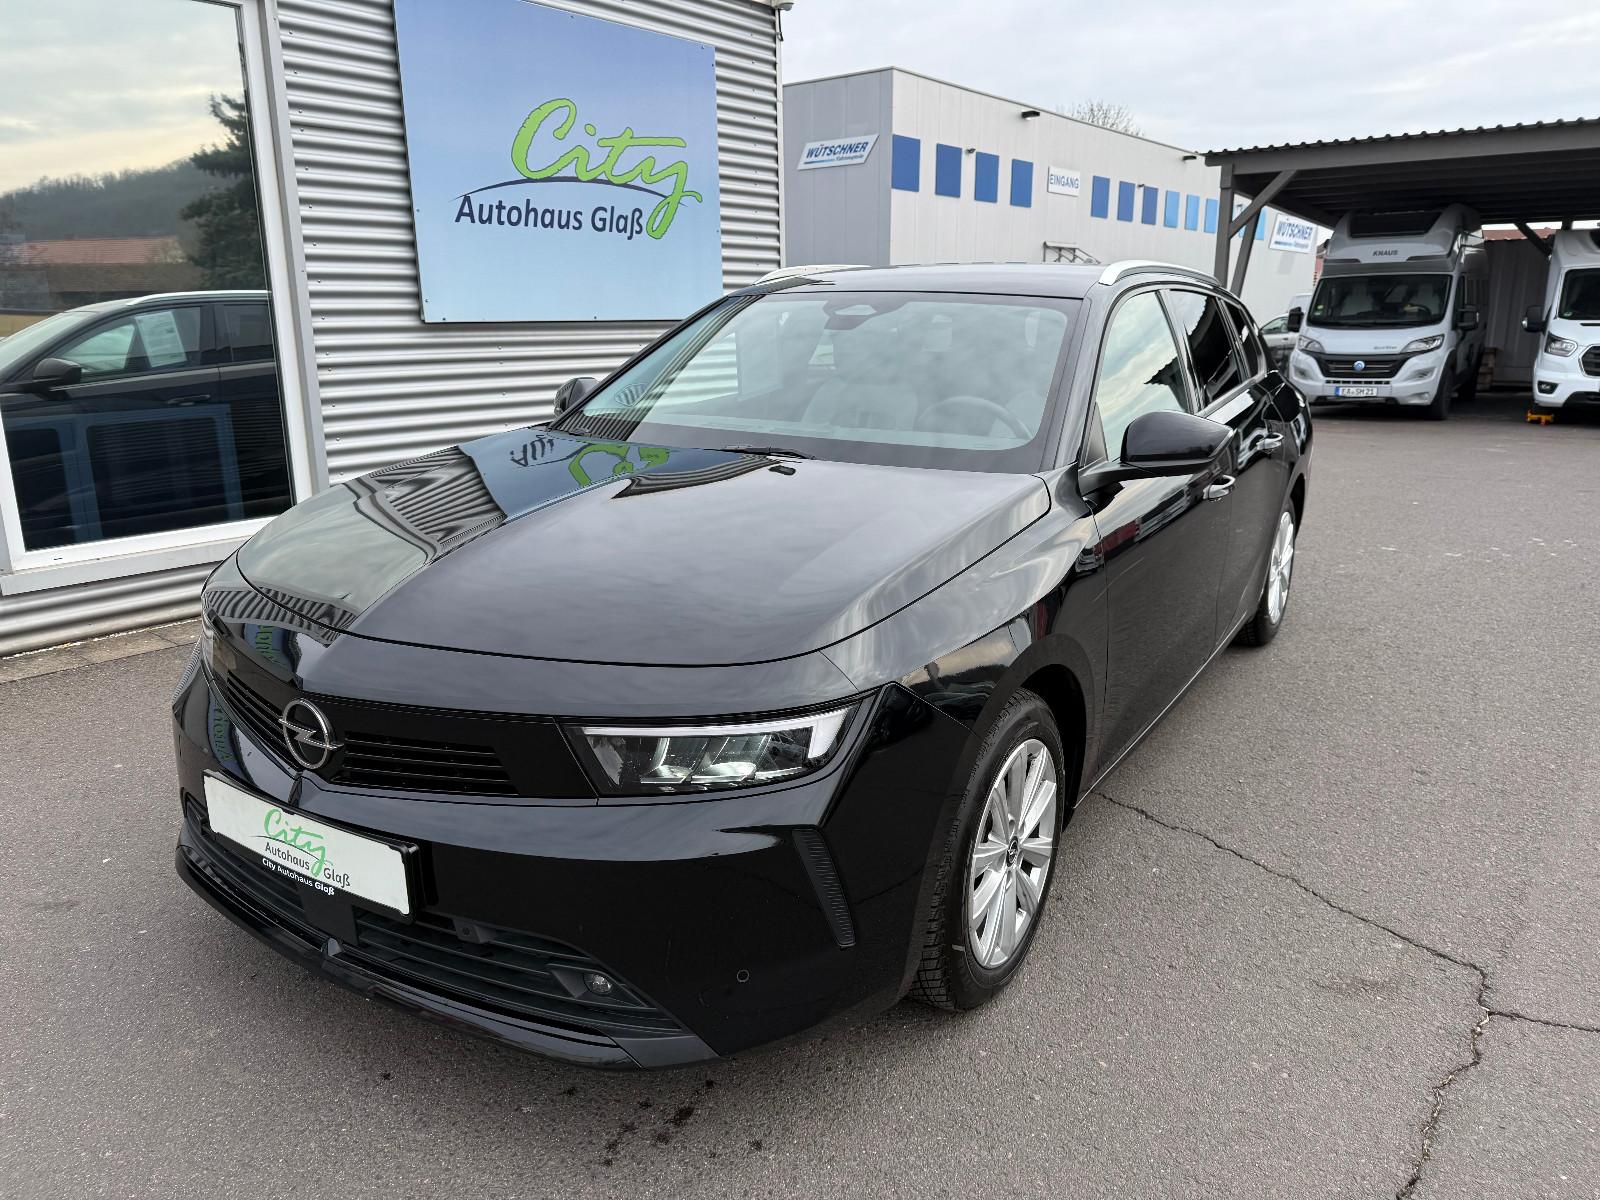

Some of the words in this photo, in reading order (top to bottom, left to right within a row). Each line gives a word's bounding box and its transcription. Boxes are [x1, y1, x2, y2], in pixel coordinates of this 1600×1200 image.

[511, 98, 703, 240] City
[806, 141, 869, 159] WÜTSCHNER
[1050, 174, 1079, 189] EINGANG
[455, 195, 583, 231] Autohaus
[591, 206, 643, 240] Glaß
[1372, 249, 1398, 257] KNAUS
[264, 809, 333, 877] City
[262, 858, 276, 870] City
[277, 864, 313, 887] Autohaus
[314, 882, 335, 895] Glaß
[265, 842, 310, 870] Autohaus
[323, 867, 350, 888] Glaß
